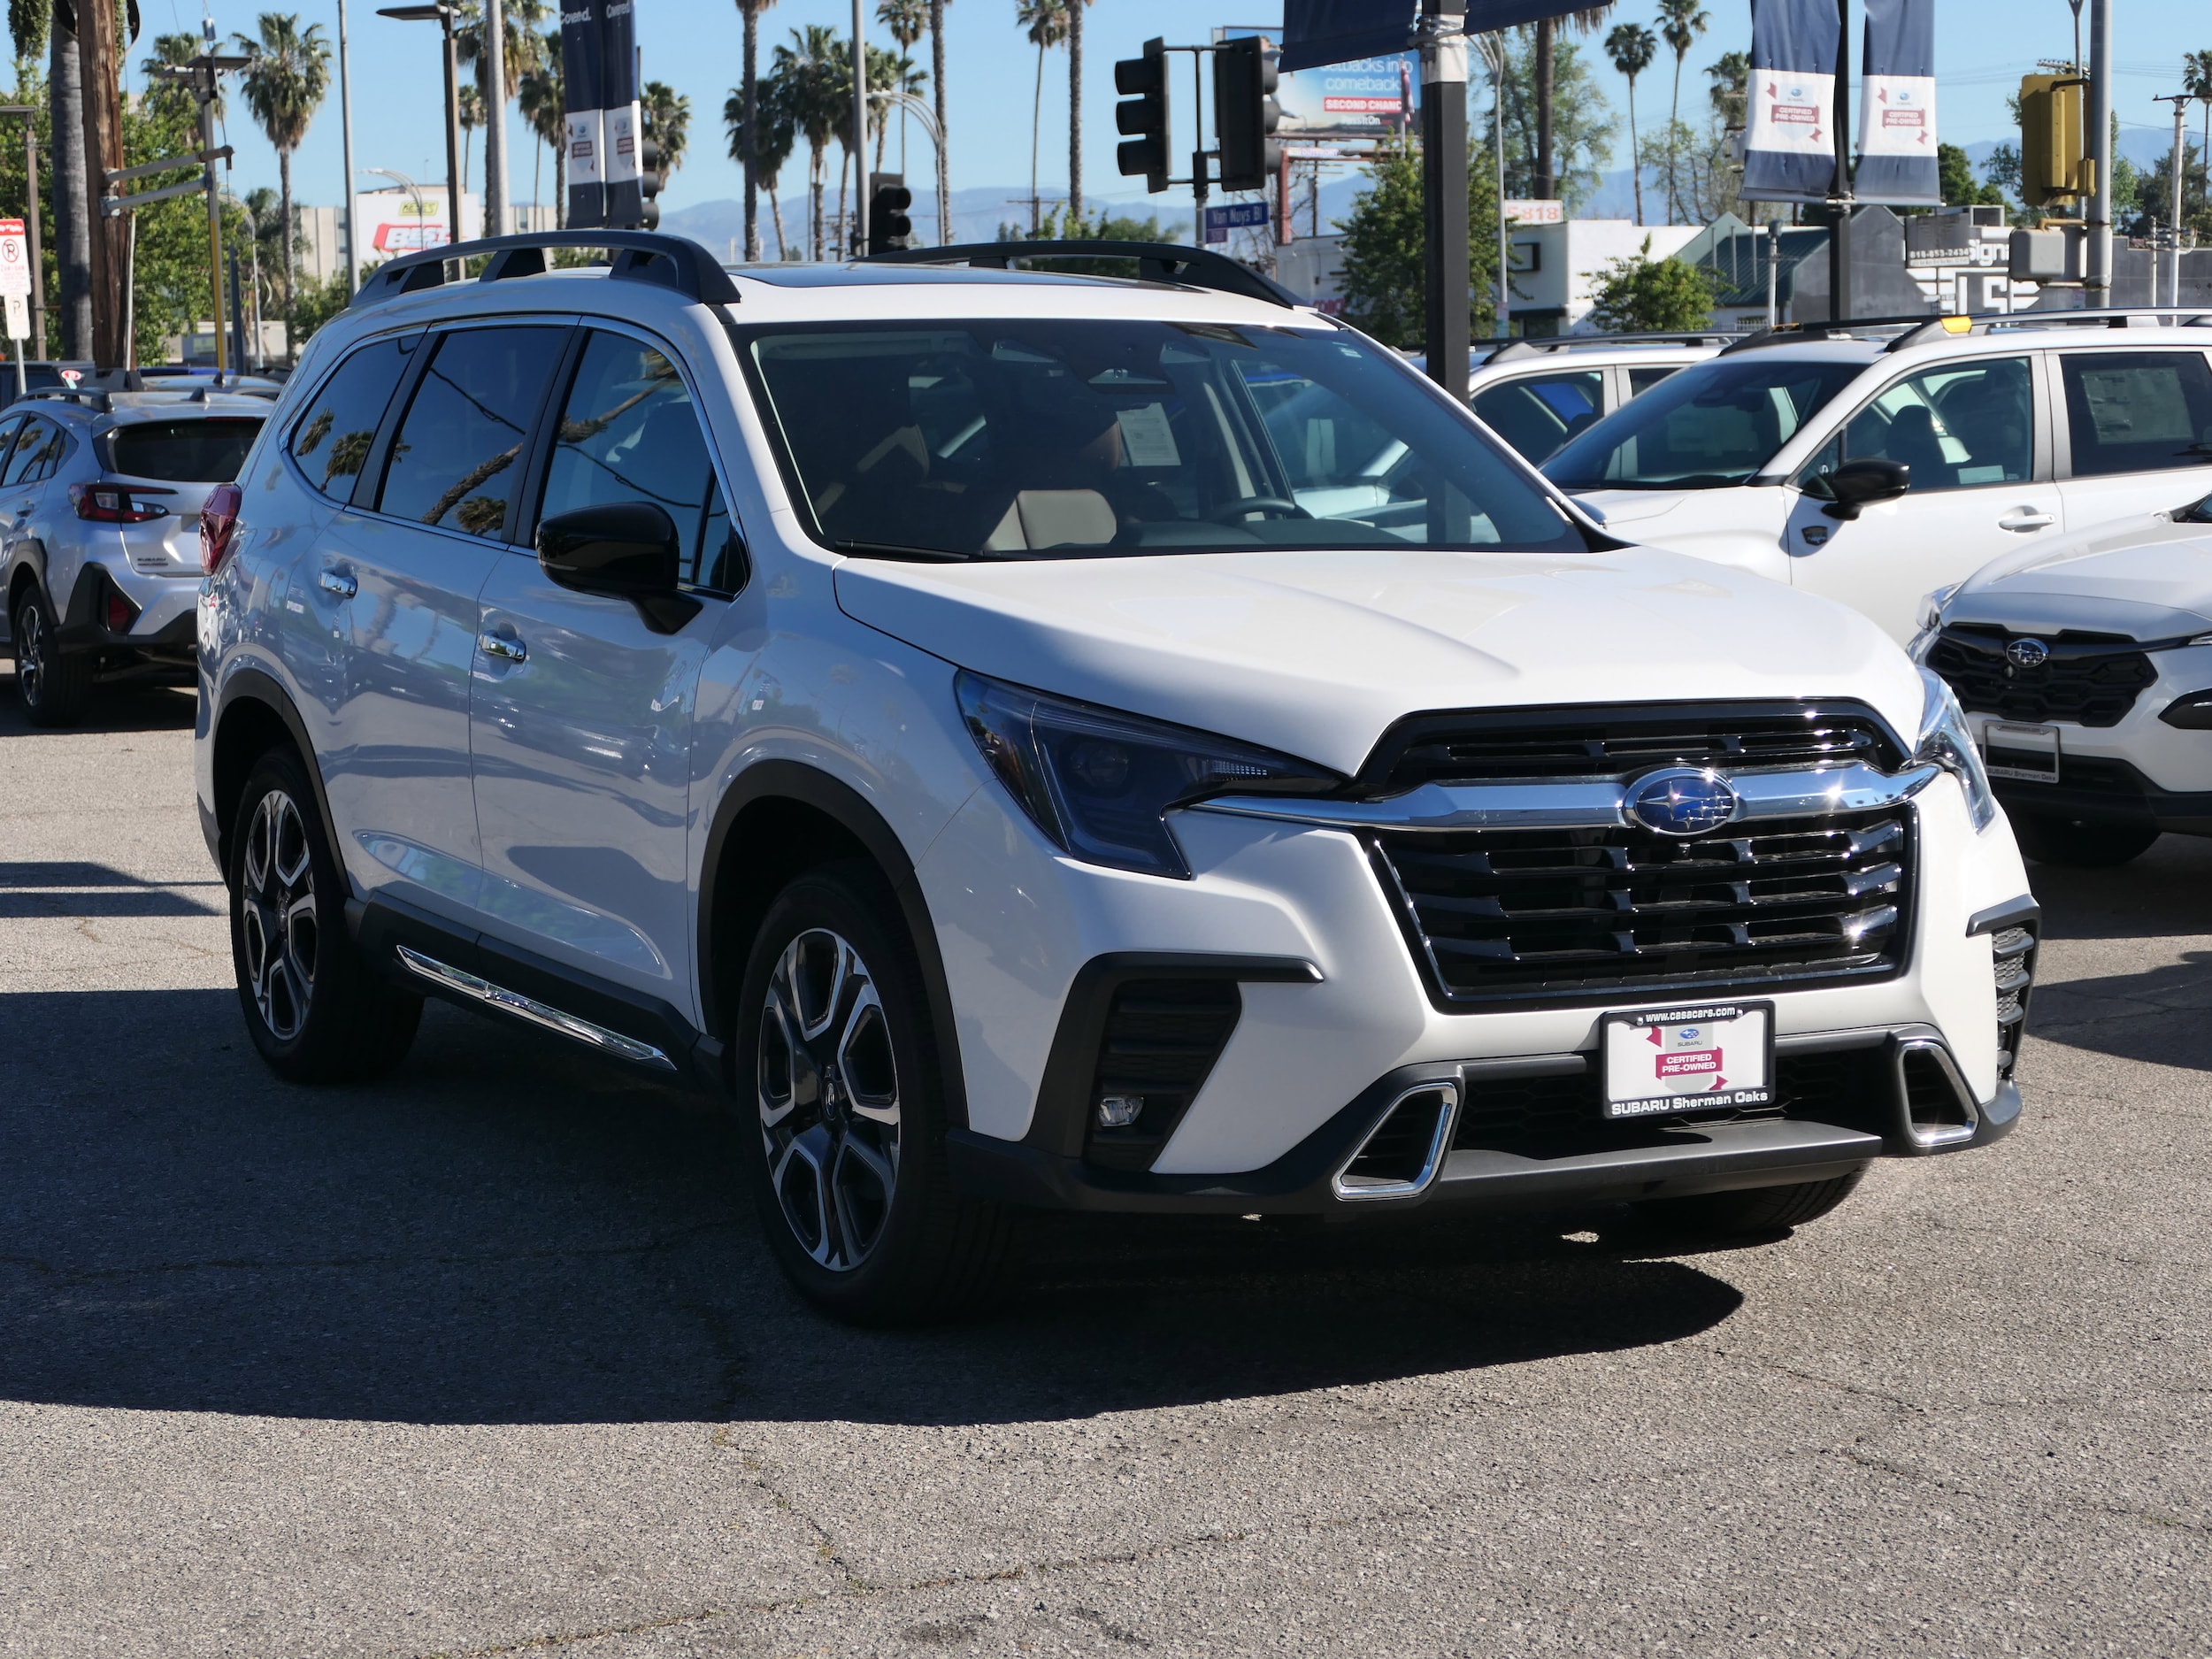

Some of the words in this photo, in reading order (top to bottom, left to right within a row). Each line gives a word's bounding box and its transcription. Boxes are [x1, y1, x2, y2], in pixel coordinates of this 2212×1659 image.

[1325, 76, 1402, 91] comeback
[1325, 99, 1367, 110] SECOND
[1368, 100, 1402, 111] CHANC
[1775, 113, 1816, 122] PRE-OWNED
[1778, 107, 1813, 116] CERTIFIED
[1212, 210, 1227, 224] Van
[1229, 208, 1251, 227] Nuys
[1645, 1007, 1736, 1023] www.casacars.com
[1666, 1053, 1712, 1064] CERTIFIED
[1662, 1062, 1717, 1073] PRE-OWNED
[1611, 1099, 1670, 1116] SUBARU
[1672, 1094, 1732, 1110] Sherman
[1734, 1091, 1769, 1103] Oaks
